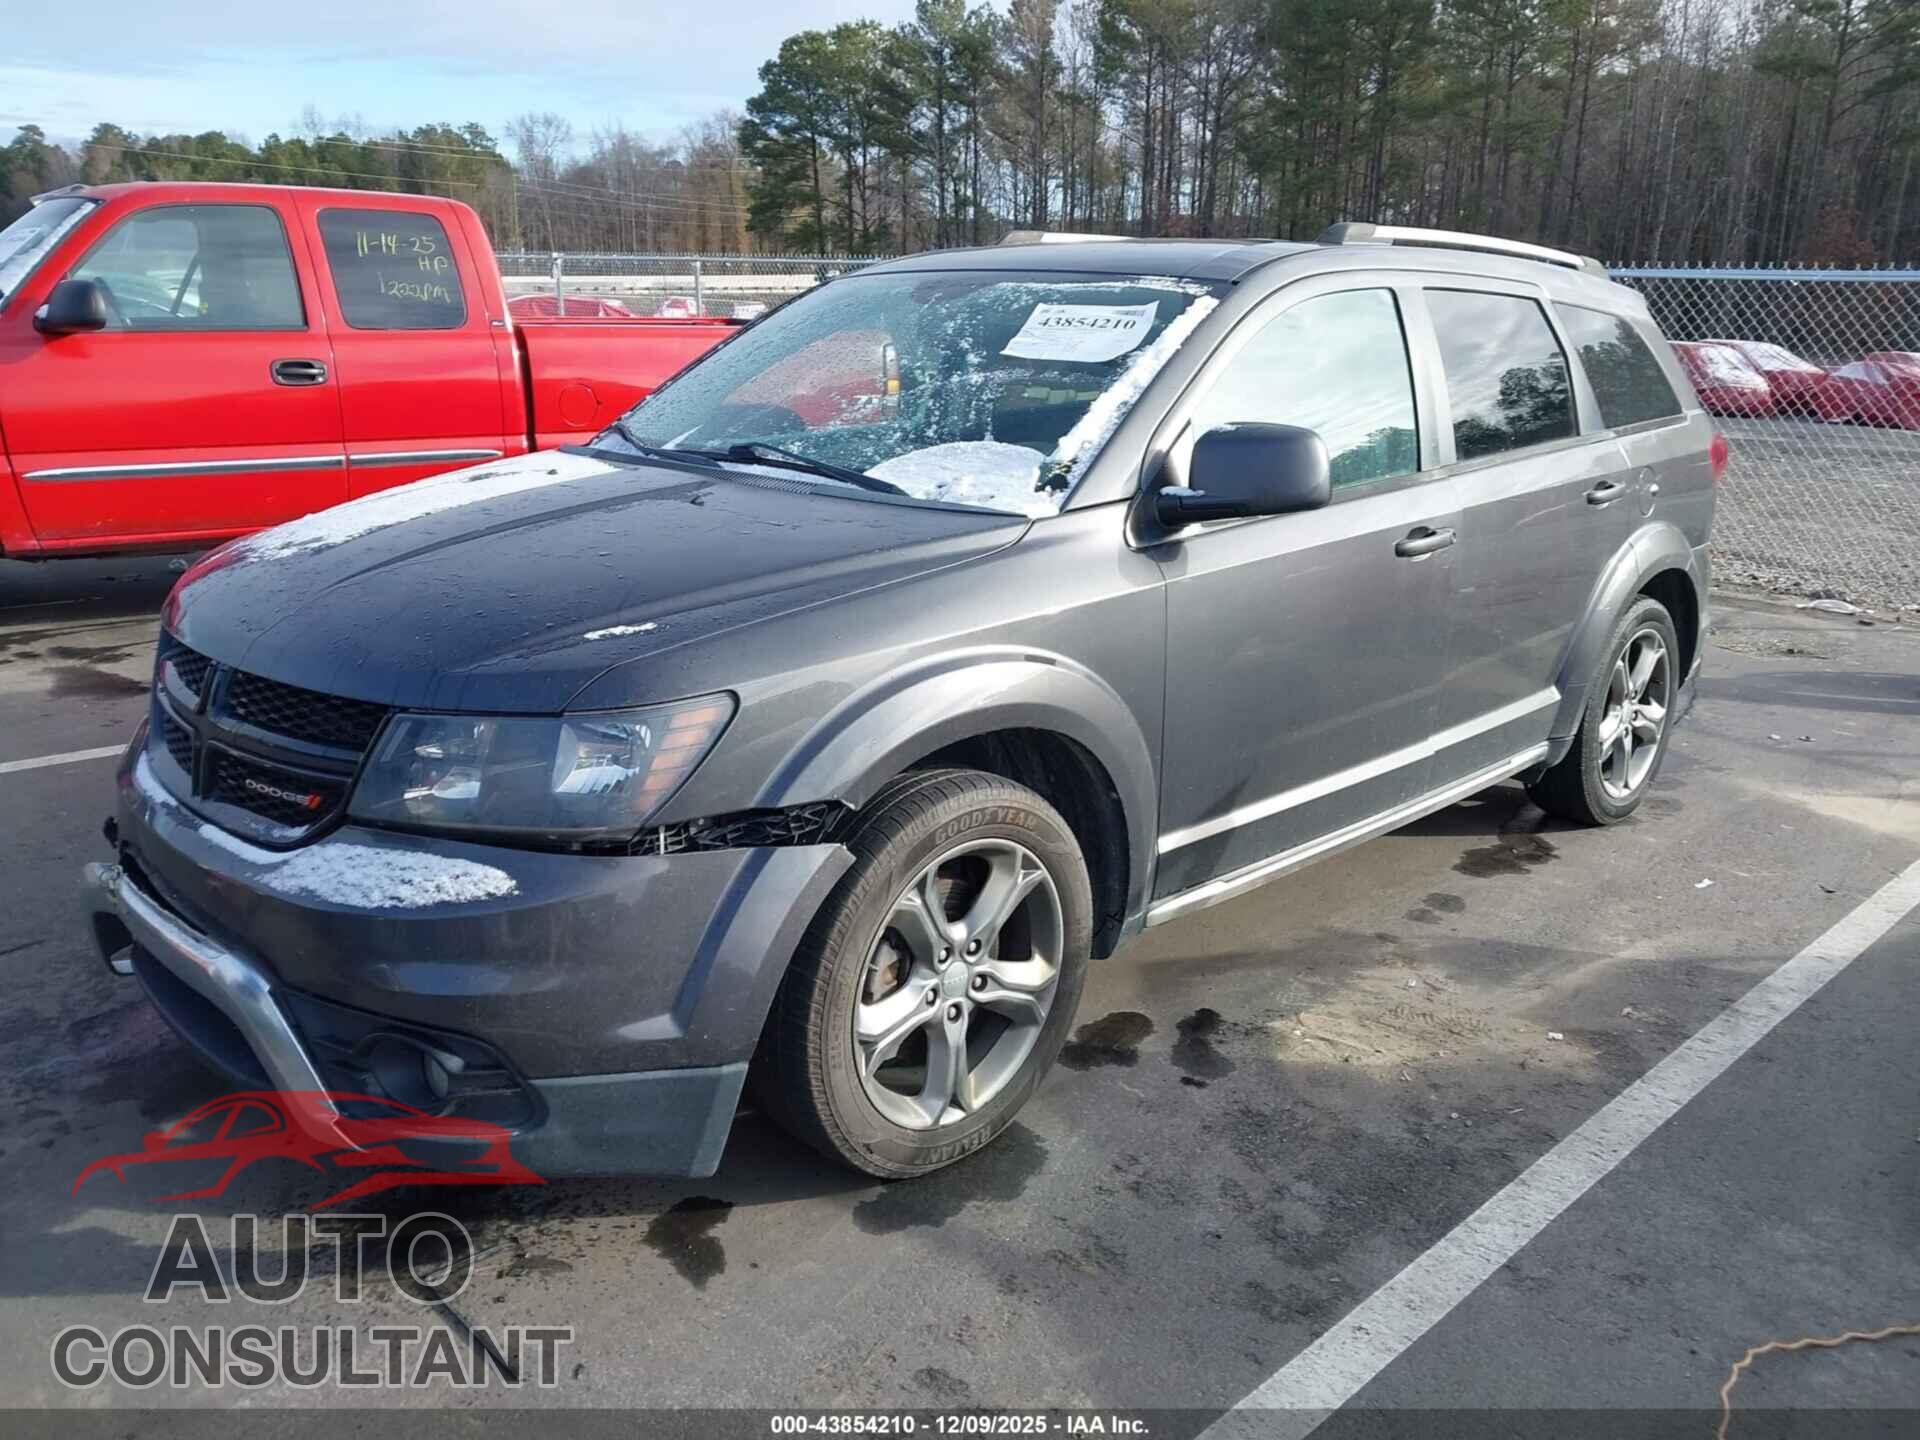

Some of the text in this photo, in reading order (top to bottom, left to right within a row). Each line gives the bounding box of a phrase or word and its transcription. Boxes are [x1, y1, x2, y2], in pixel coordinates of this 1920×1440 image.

[356, 231, 436, 257] 11-14-25
[1038, 317, 1137, 330] 43854210
[245, 779, 310, 805] DODGE
[934, 806, 1036, 843] GOODYEAR
